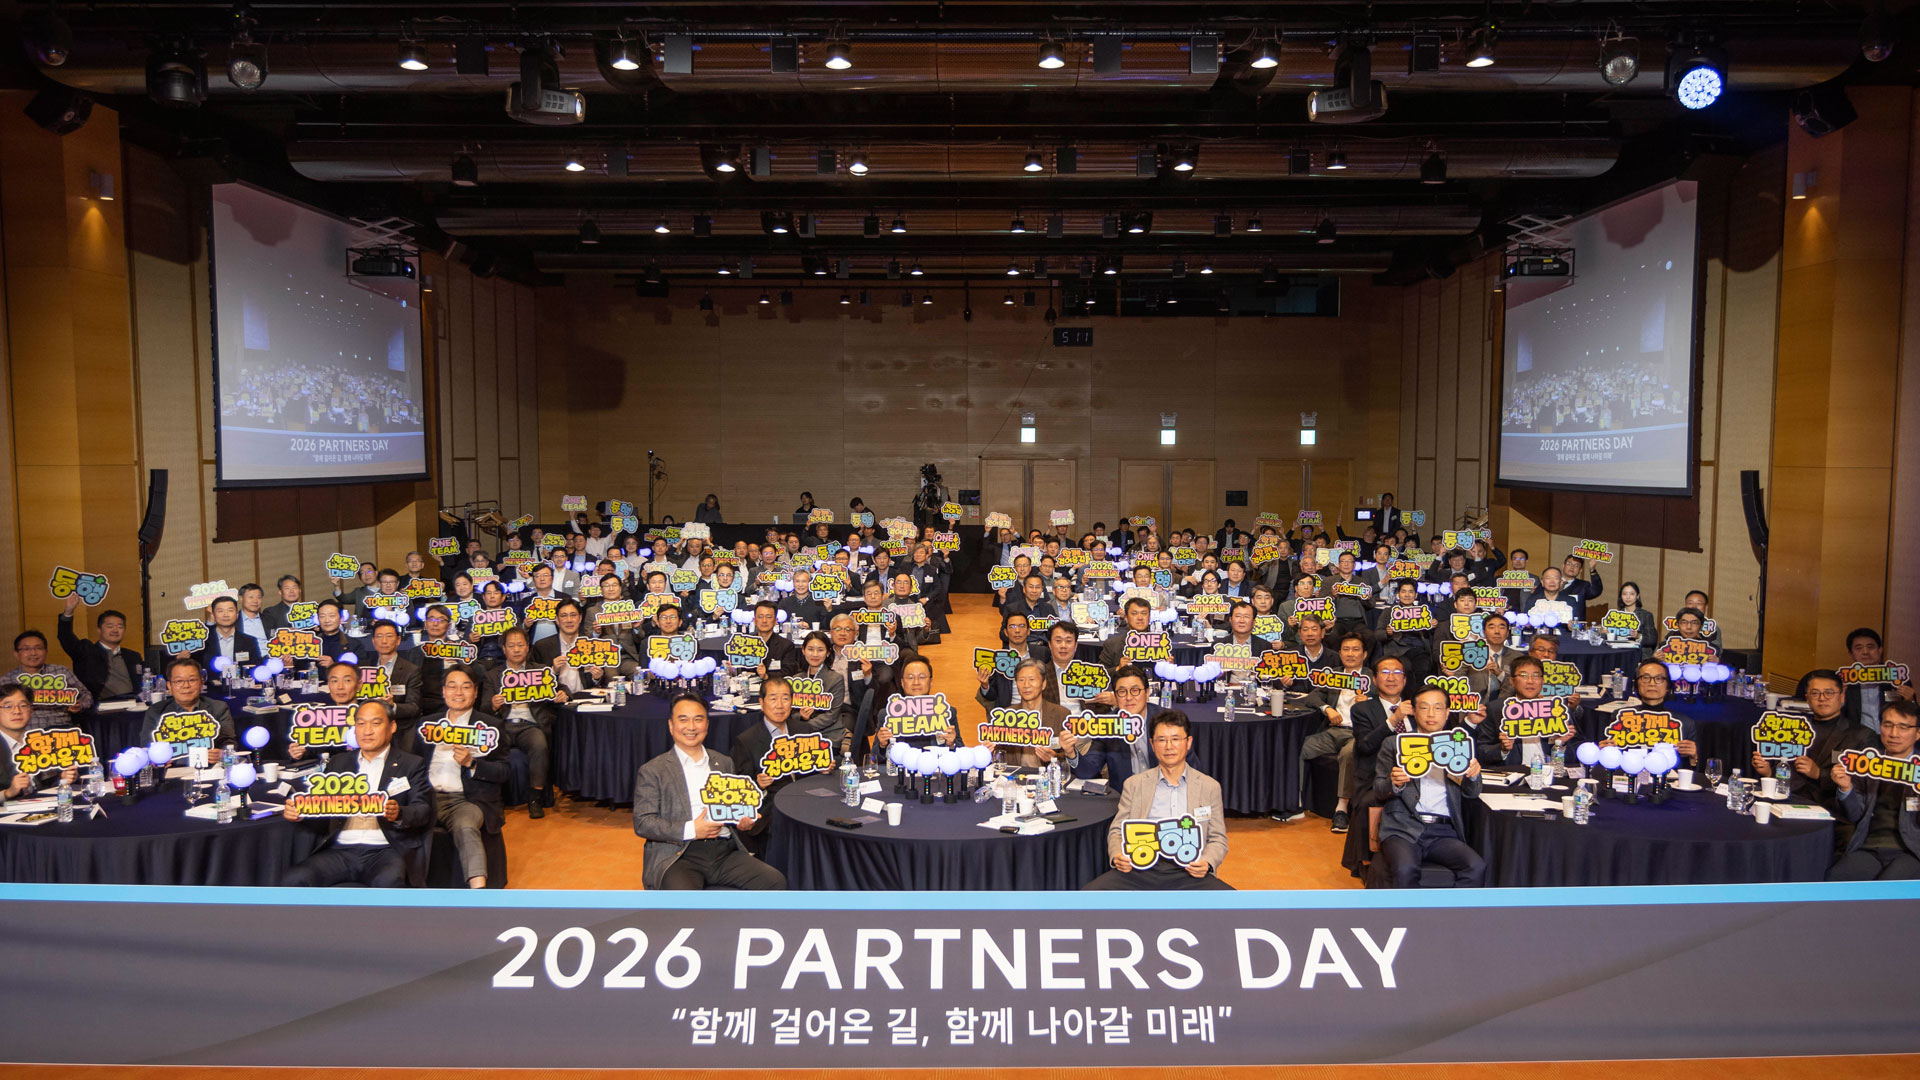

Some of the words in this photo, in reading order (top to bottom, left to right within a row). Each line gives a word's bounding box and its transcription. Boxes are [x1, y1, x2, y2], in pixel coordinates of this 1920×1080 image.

[291, 438, 316, 451] 2026
[319, 439, 370, 452] PARTNERS
[372, 440, 389, 450] DAY
[1540, 440, 1560, 451] 2026
[1561, 438, 1611, 451] PARTNERS
[1613, 436, 1634, 448] DAY
[563, 503, 586, 511] TEAM
[1401, 512, 1425, 525] 동행
[431, 540, 451, 548] ONE
[933, 541, 959, 550] TEAM
[935, 534, 954, 542] ONE
[1444, 532, 1474, 549] 동행
[432, 547, 459, 555] TEAM
[1335, 542, 1354, 550] ONE
[1581, 540, 1607, 552] 2026
[510, 551, 530, 559] 2026
[714, 550, 734, 558] 2026
[1137, 552, 1155, 561] ONE
[1573, 548, 1601, 561] PARTNERS
[1600, 552, 1613, 562] DAY
[330, 569, 355, 578] 미래
[468, 568, 493, 577] 2026
[1091, 562, 1113, 570] 2026
[760, 572, 791, 582] TOGETHER
[1503, 571, 1528, 580] 2026
[51, 569, 107, 605] 동행
[993, 580, 1013, 588] 미래
[1336, 584, 1370, 595] TOGETHER
[367, 597, 408, 607] TOGETHER
[701, 591, 736, 612] 동행
[814, 590, 838, 599] 미래
[1195, 596, 1222, 605] 2026
[1495, 597, 1506, 607] DAY
[604, 603, 634, 614] 2026
[1187, 604, 1218, 613] PARTNERS
[1218, 604, 1230, 613] DAY
[1296, 600, 1325, 611] ONE
[474, 611, 506, 624] ONE
[597, 612, 630, 624] PARTNERS
[630, 610, 642, 621] DAY
[852, 611, 895, 623] TOGETHER
[1392, 608, 1421, 620] ONE
[169, 621, 197, 633] 함께
[1392, 618, 1430, 630] TEAM
[162, 628, 206, 643] 나아갈
[277, 630, 314, 645] 함께
[733, 635, 758, 647] 함께
[1127, 633, 1161, 647] ONE
[168, 639, 203, 654] 미래
[426, 643, 476, 658] TOGETHER
[576, 639, 611, 655] 함께
[650, 637, 696, 661] 동행
[727, 644, 767, 658] 나아갈
[1126, 647, 1169, 660] TEAM
[1215, 645, 1250, 658] 2026
[1669, 638, 1706, 654] 함께
[731, 655, 761, 666] 미래
[846, 647, 899, 661] TOGETHER
[1263, 652, 1298, 668] 함께
[1442, 642, 1489, 670] 동행
[1071, 663, 1100, 677] 함께
[1842, 666, 1907, 683] TOGETHER
[503, 672, 543, 688] ONE
[1061, 674, 1109, 689] 나아갈
[1312, 671, 1368, 691] TOGETHER
[58, 690, 77, 703] DAY
[503, 685, 555, 702] TEAM
[1067, 685, 1101, 699] 미래
[815, 693, 832, 708] DAY
[888, 698, 935, 717] ONE
[1461, 694, 1479, 711] DAY
[296, 708, 347, 728] ONE
[1505, 701, 1550, 720] ONE
[164, 713, 202, 730] 함께
[888, 714, 949, 735] TEAM
[993, 710, 1040, 729] 2026
[1069, 717, 1142, 736] TOGETHER
[1504, 717, 1567, 737] TEAM
[1620, 711, 1669, 733] 함께
[1764, 714, 1800, 730] 함께
[155, 723, 217, 743] 나아갈
[425, 724, 496, 747] TOGETHER
[979, 725, 1031, 744] PARTNERS
[1032, 728, 1052, 746] DAY
[1754, 729, 1812, 746] 나아갈
[27, 731, 80, 754] 함께
[774, 736, 820, 759] 함께
[1760, 742, 1804, 757] 미래
[1400, 735, 1471, 776] 동행
[1847, 752, 1920, 783] TOGETHE
[309, 775, 369, 795] 2026
[709, 774, 746, 792] 함께
[700, 788, 761, 806] 나아갈
[294, 795, 360, 815] PARTNERS
[361, 795, 385, 813] DAY
[710, 804, 755, 821] 미래
[1125, 820, 1200, 866] 동행
[492, 926, 702, 989] 2026
[733, 927, 1204, 990] PARTNERS
[1234, 927, 1407, 989] DAY
[770, 1008, 874, 1045] 걸어온
[887, 1008, 929, 1048] 길,
[945, 1007, 1013, 1045] 함께
[1028, 1007, 1133, 1045] 나아갈
